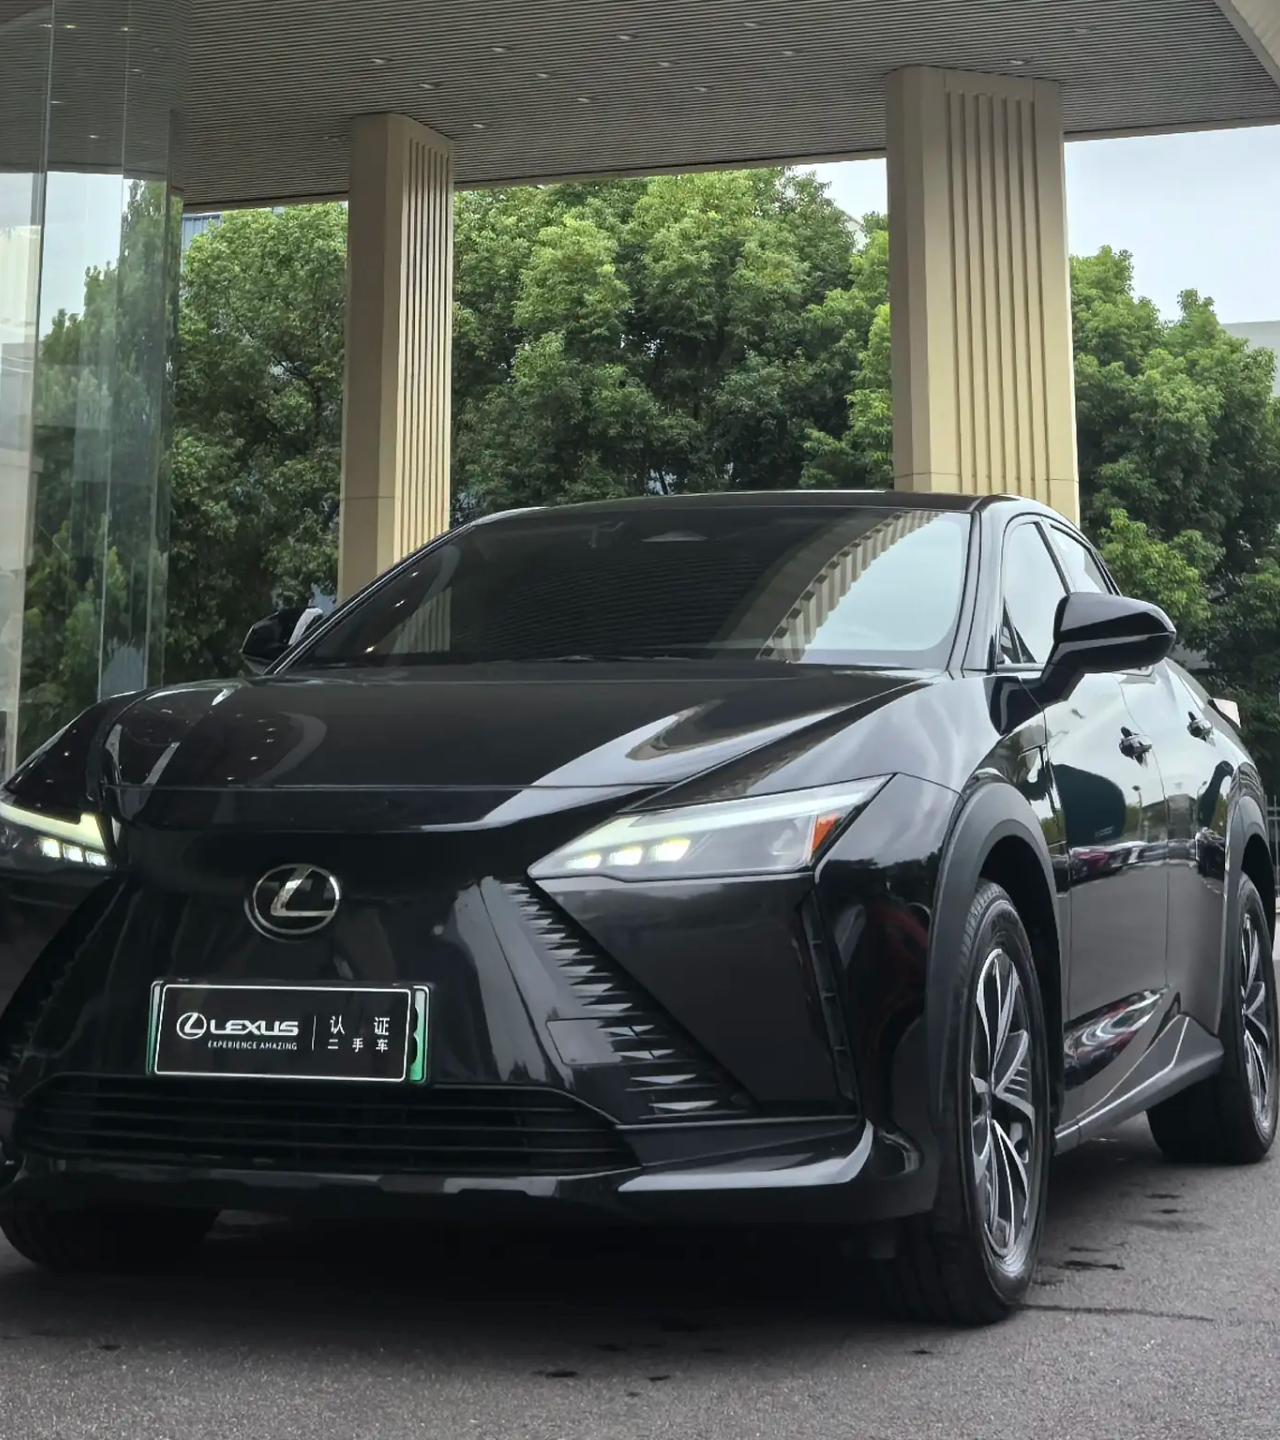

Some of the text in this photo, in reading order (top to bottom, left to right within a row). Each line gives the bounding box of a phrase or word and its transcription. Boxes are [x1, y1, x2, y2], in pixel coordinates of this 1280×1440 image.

[210, 1019, 299, 1036] LEXUS
[329, 1014, 390, 1037] 认证
[208, 1040, 298, 1051] EXPERIENCE AMAZING
[327, 1038, 389, 1054] 二手车
